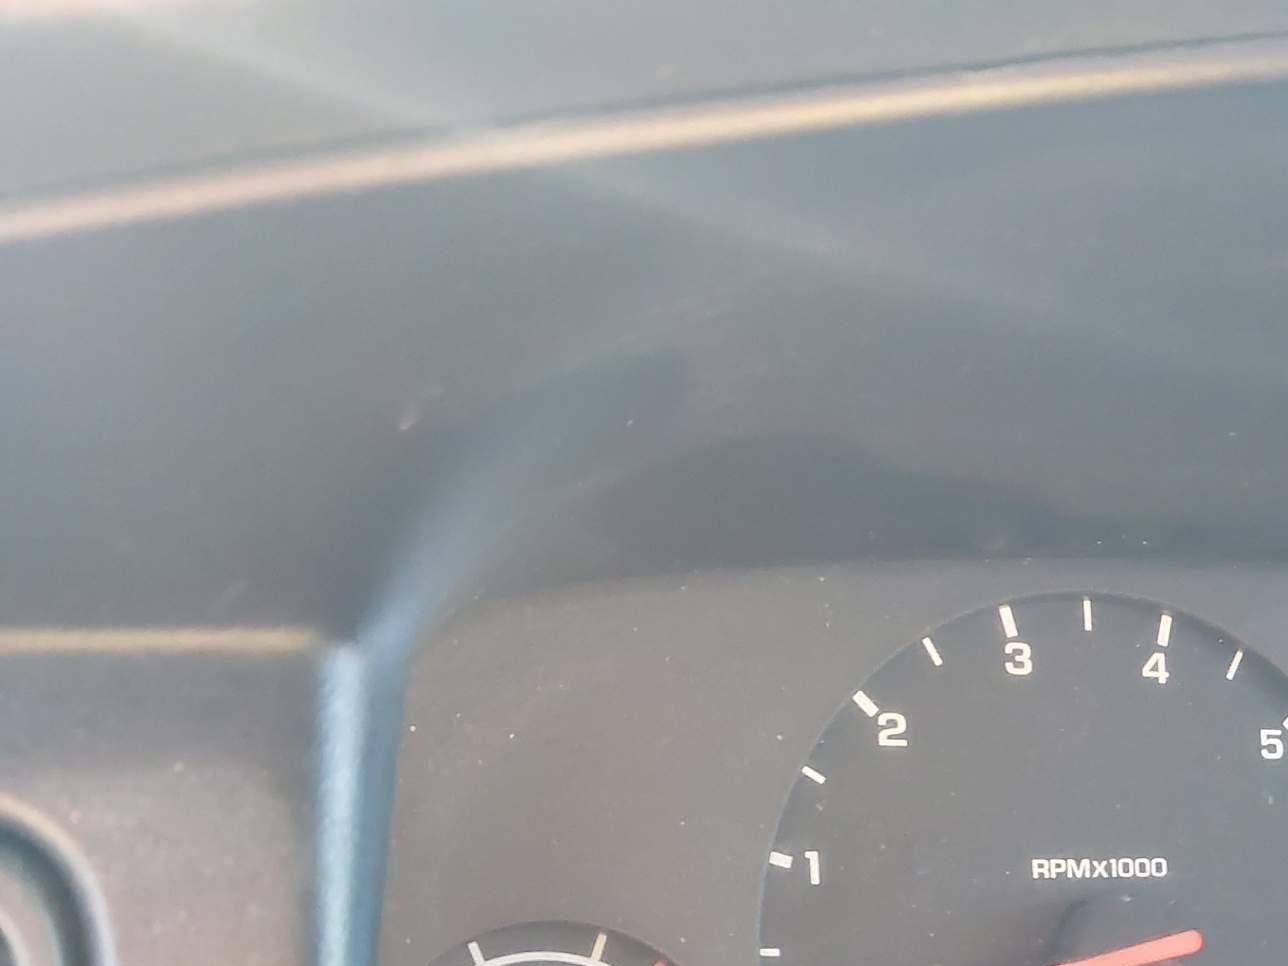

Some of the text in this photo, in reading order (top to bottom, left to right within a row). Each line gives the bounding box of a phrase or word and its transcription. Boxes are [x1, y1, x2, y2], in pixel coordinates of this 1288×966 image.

[1004, 643, 1033, 675] 3
[1142, 652, 1169, 684] 4
[877, 713, 908, 747] 2
[1260, 729, 1283, 759] 5
[803, 850, 821, 885] 1
